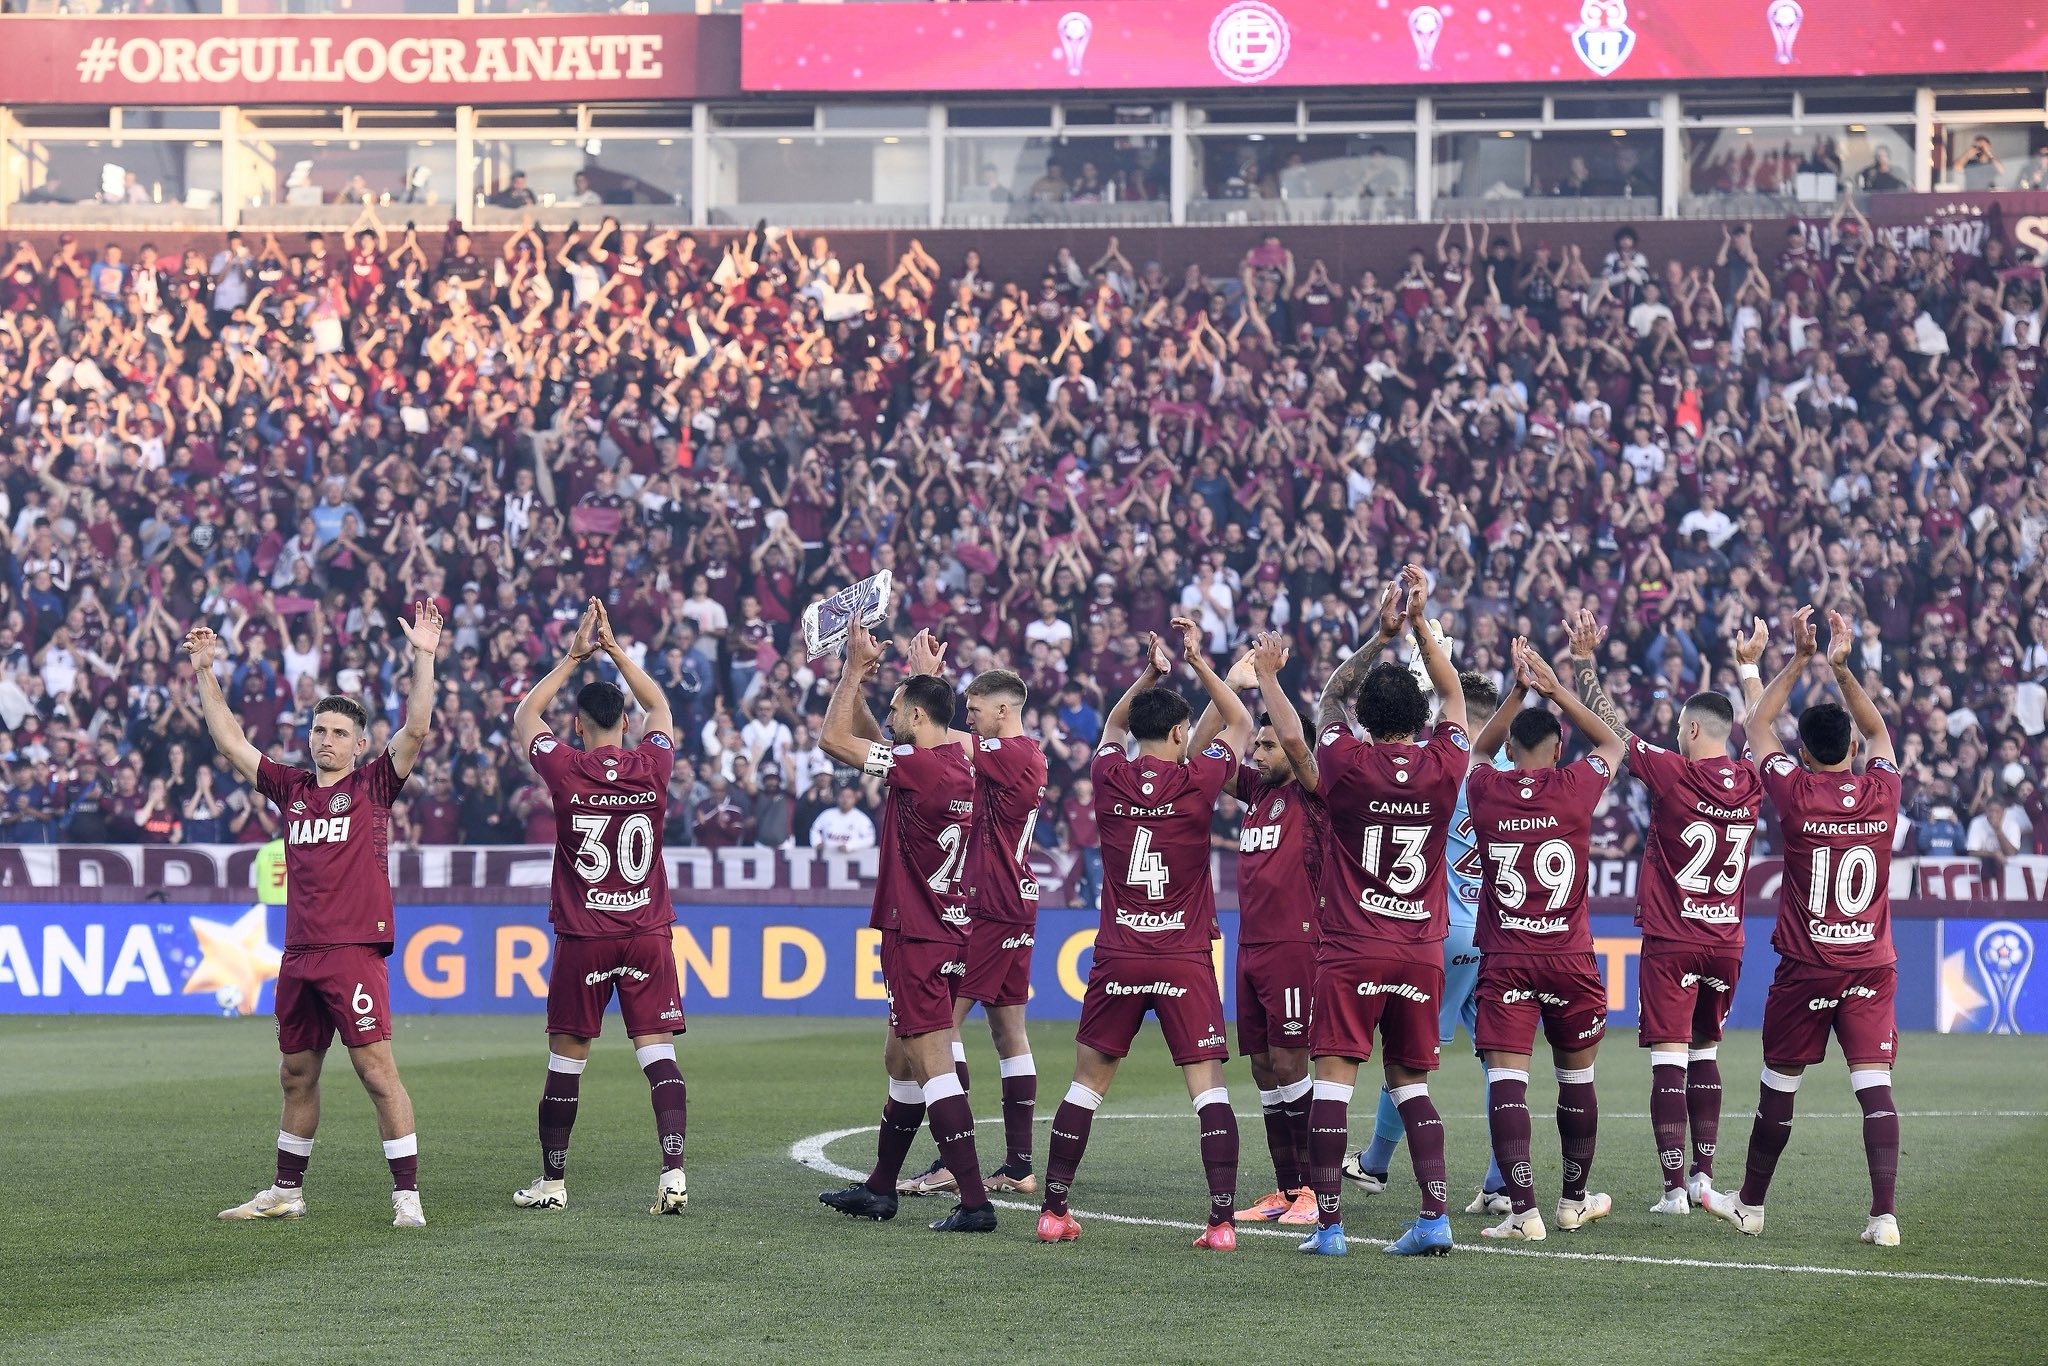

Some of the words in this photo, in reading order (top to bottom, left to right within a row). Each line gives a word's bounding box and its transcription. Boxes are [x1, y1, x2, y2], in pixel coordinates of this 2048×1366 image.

[77, 35, 662, 82] #ORGULLOGRANATE
[570, 793, 584, 805] A.
[589, 791, 657, 806] CARDOZO
[949, 799, 974, 814] IZQUIER
[1130, 803, 1175, 816] PEREZ
[1369, 801, 1431, 815] CANALE
[1697, 801, 1751, 819] CARRERA
[289, 817, 351, 845] MAPEI
[1240, 824, 1282, 852] APEI
[1498, 816, 1558, 832] MEDINA
[1803, 820, 1888, 835] MARCELINO
[572, 813, 653, 884] 30
[1127, 825, 1170, 900] 4
[1362, 825, 1433, 894] 13
[1675, 821, 1755, 895] 23
[1488, 839, 1576, 912] 39
[1808, 845, 1878, 917] 10
[586, 887, 650, 906] CartaSur
[1809, 920, 1875, 940] CartaSur
[352, 982, 374, 1015] 6
[1105, 981, 1187, 998] Chevallier
[1284, 987, 1301, 1018] 11
